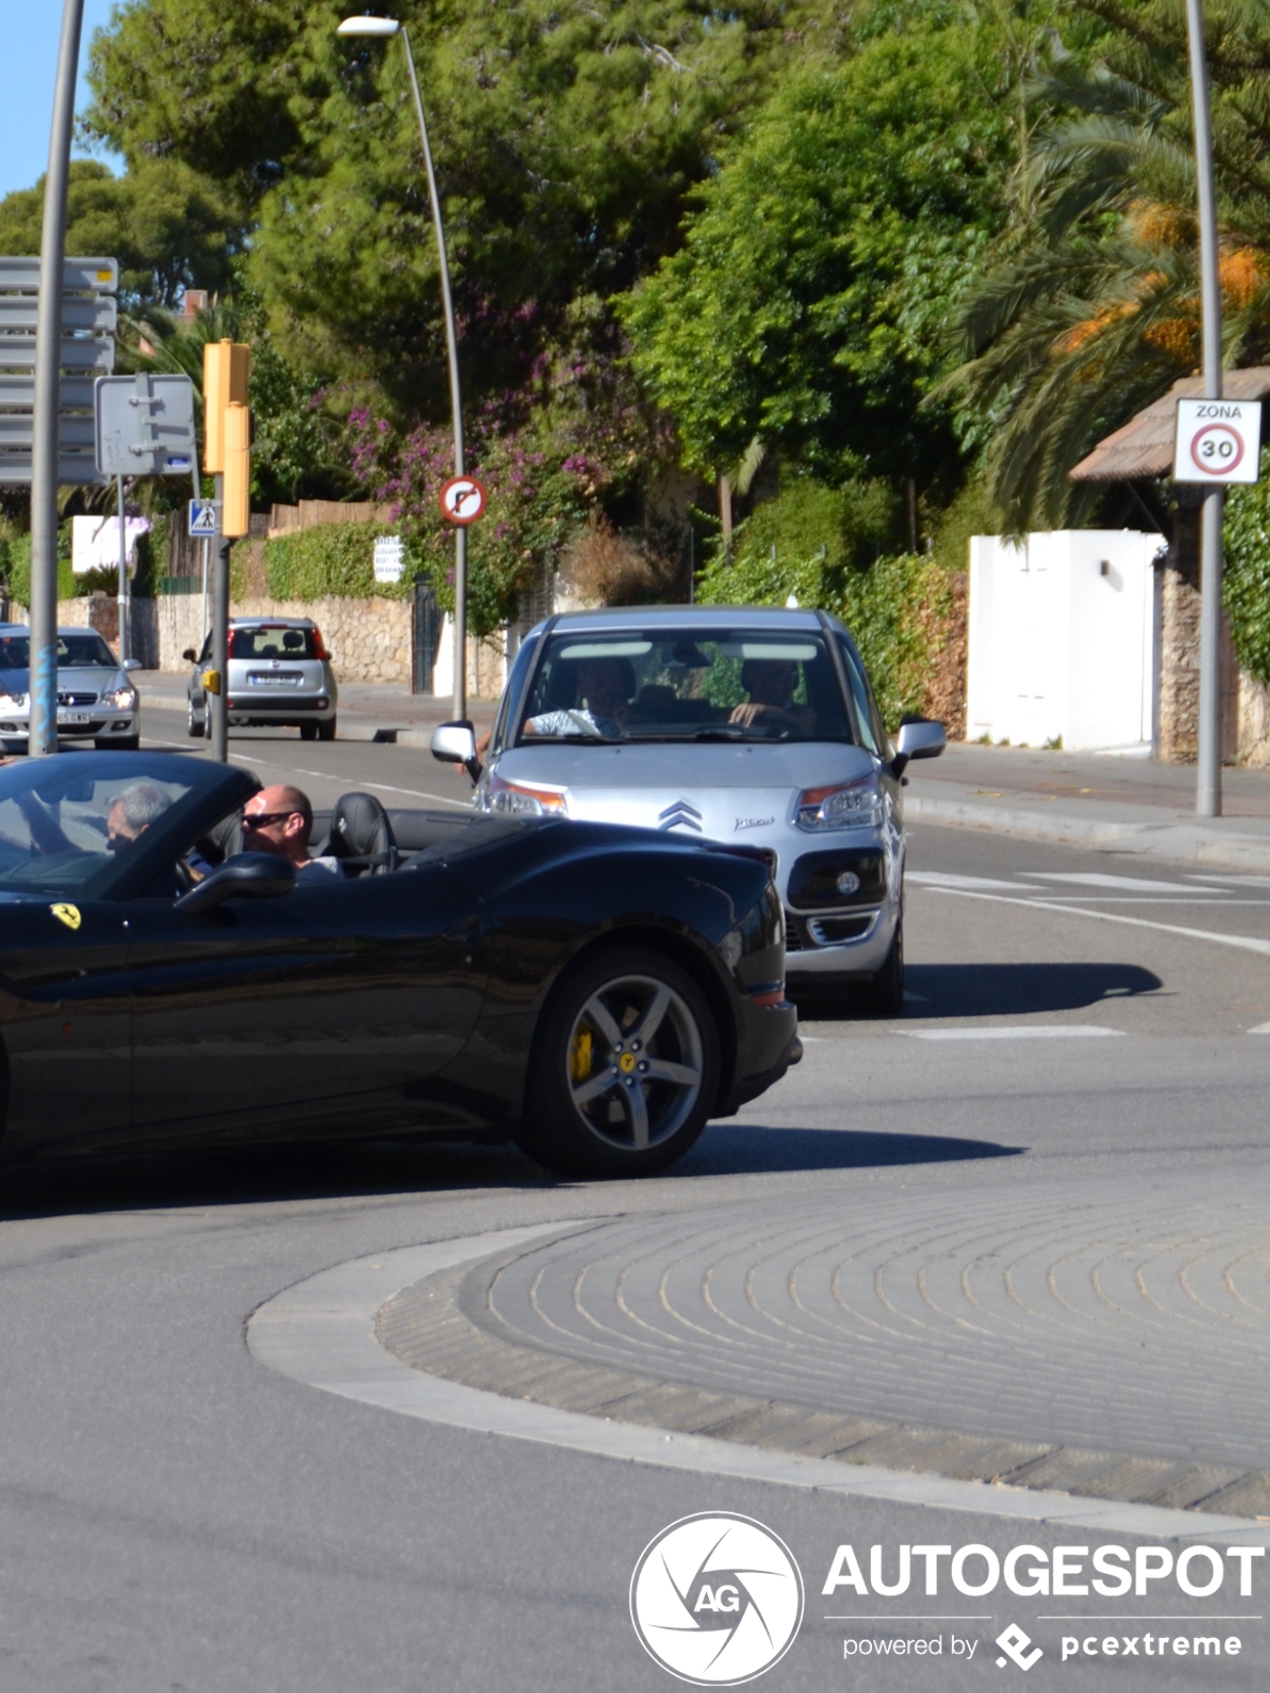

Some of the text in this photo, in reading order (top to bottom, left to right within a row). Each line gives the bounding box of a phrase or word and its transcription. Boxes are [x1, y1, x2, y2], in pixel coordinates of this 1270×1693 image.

[1196, 405, 1242, 418] ZONA
[1202, 440, 1233, 458] 30
[58, 713, 69, 722] 65
